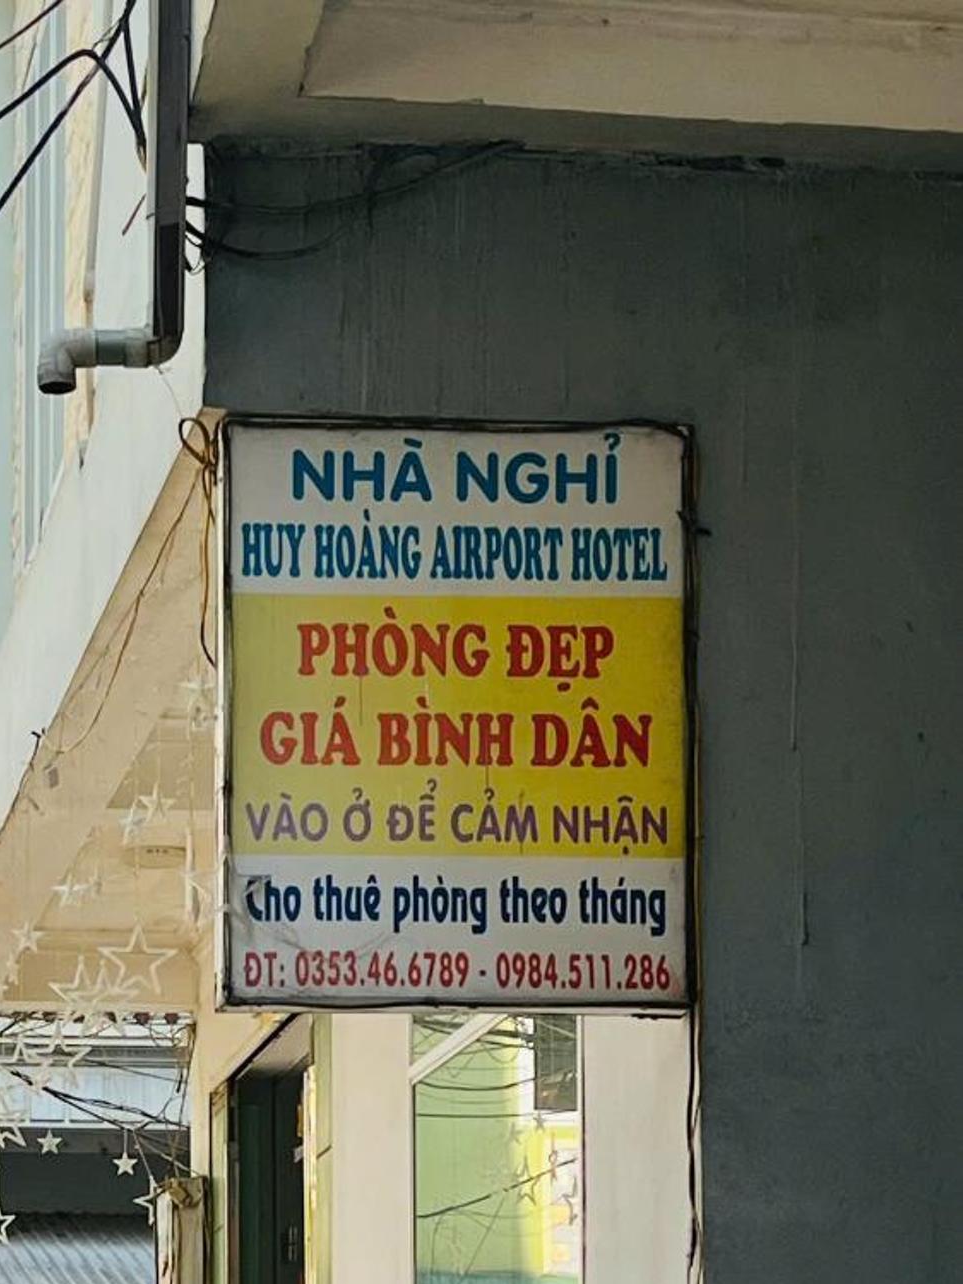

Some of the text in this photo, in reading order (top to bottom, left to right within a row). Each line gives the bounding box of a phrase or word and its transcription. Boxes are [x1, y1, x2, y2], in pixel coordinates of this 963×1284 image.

[293, 433, 622, 504] NHÀ NGHỈ
[241, 508, 668, 582] HUY HOÀNG AIRPORT HOTEL
[297, 606, 615, 693] PHÒNG ĐẸP
[260, 695, 653, 768] GIÁ BÌNH DÂN
[245, 778, 668, 856] VÀO Ở ĐỂ CẢM NHẬN
[245, 873, 667, 937] Cho thuê phòng theo tháng
[243, 952, 286, 988] ĐT:
[294, 951, 469, 989] 0353.46.6789
[496, 953, 671, 991] 0984.511.286
